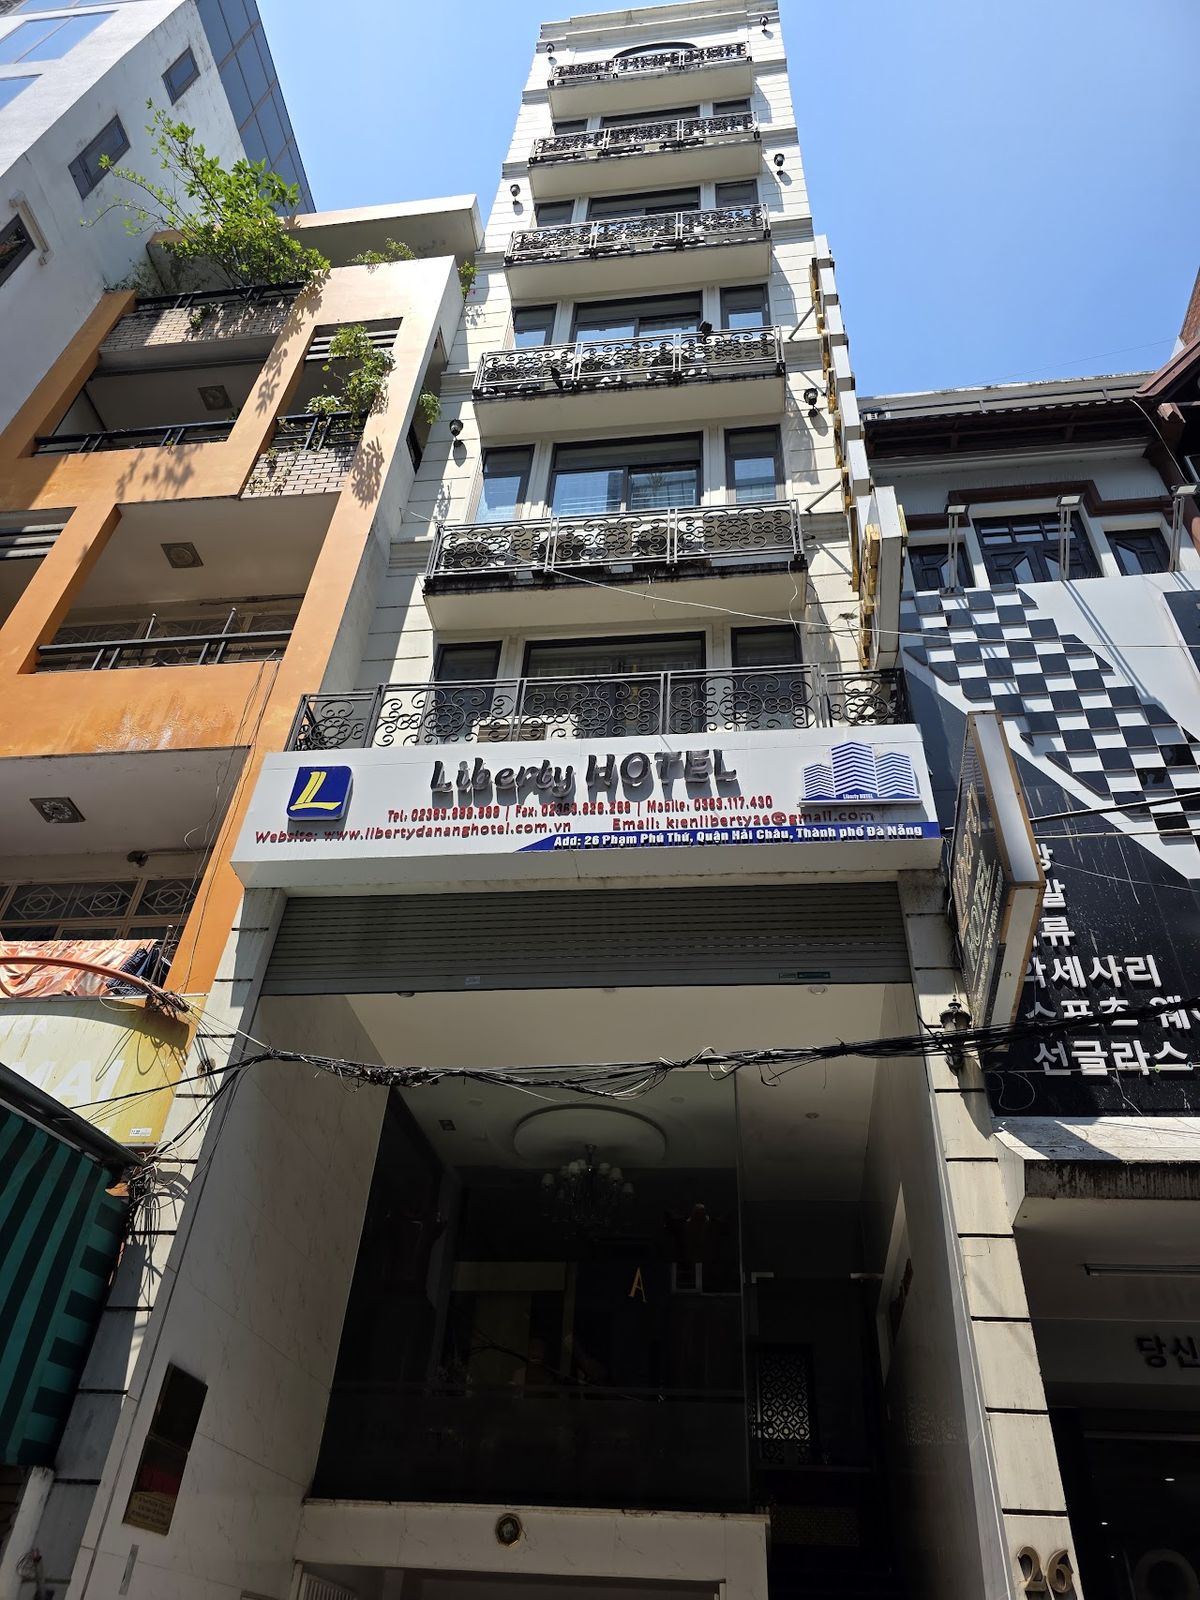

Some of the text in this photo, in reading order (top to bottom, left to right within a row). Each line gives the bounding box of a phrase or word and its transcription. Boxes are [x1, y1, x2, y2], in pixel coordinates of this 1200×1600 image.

[430, 749, 738, 798] Liberty HOTEL
[388, 810, 408, 823] Tel:
[515, 805, 538, 818] Fax:
[647, 799, 690, 814] Mobile:
[255, 831, 318, 844] Website:
[323, 822, 572, 842] www.libertydananghotel.com.vn
[612, 817, 660, 831] Email:
[553, 836, 581, 847] Add:
[584, 836, 600, 846] 26
[602, 835, 637, 848] Phạm
[640, 833, 664, 845] Phú
[697, 830, 729, 845] Quận
[732, 829, 753, 840] Hải
[756, 827, 794, 840] Châu,
[797, 827, 837, 839] Thành
[839, 825, 864, 839] phố
[866, 825, 886, 837] Đà
[887, 823, 923, 836] Nẵng
[1149, 995, 1200, 1030] 웨
[1034, 1039, 1194, 1076] 선글라스
[1016, 1546, 1074, 1594] 26
